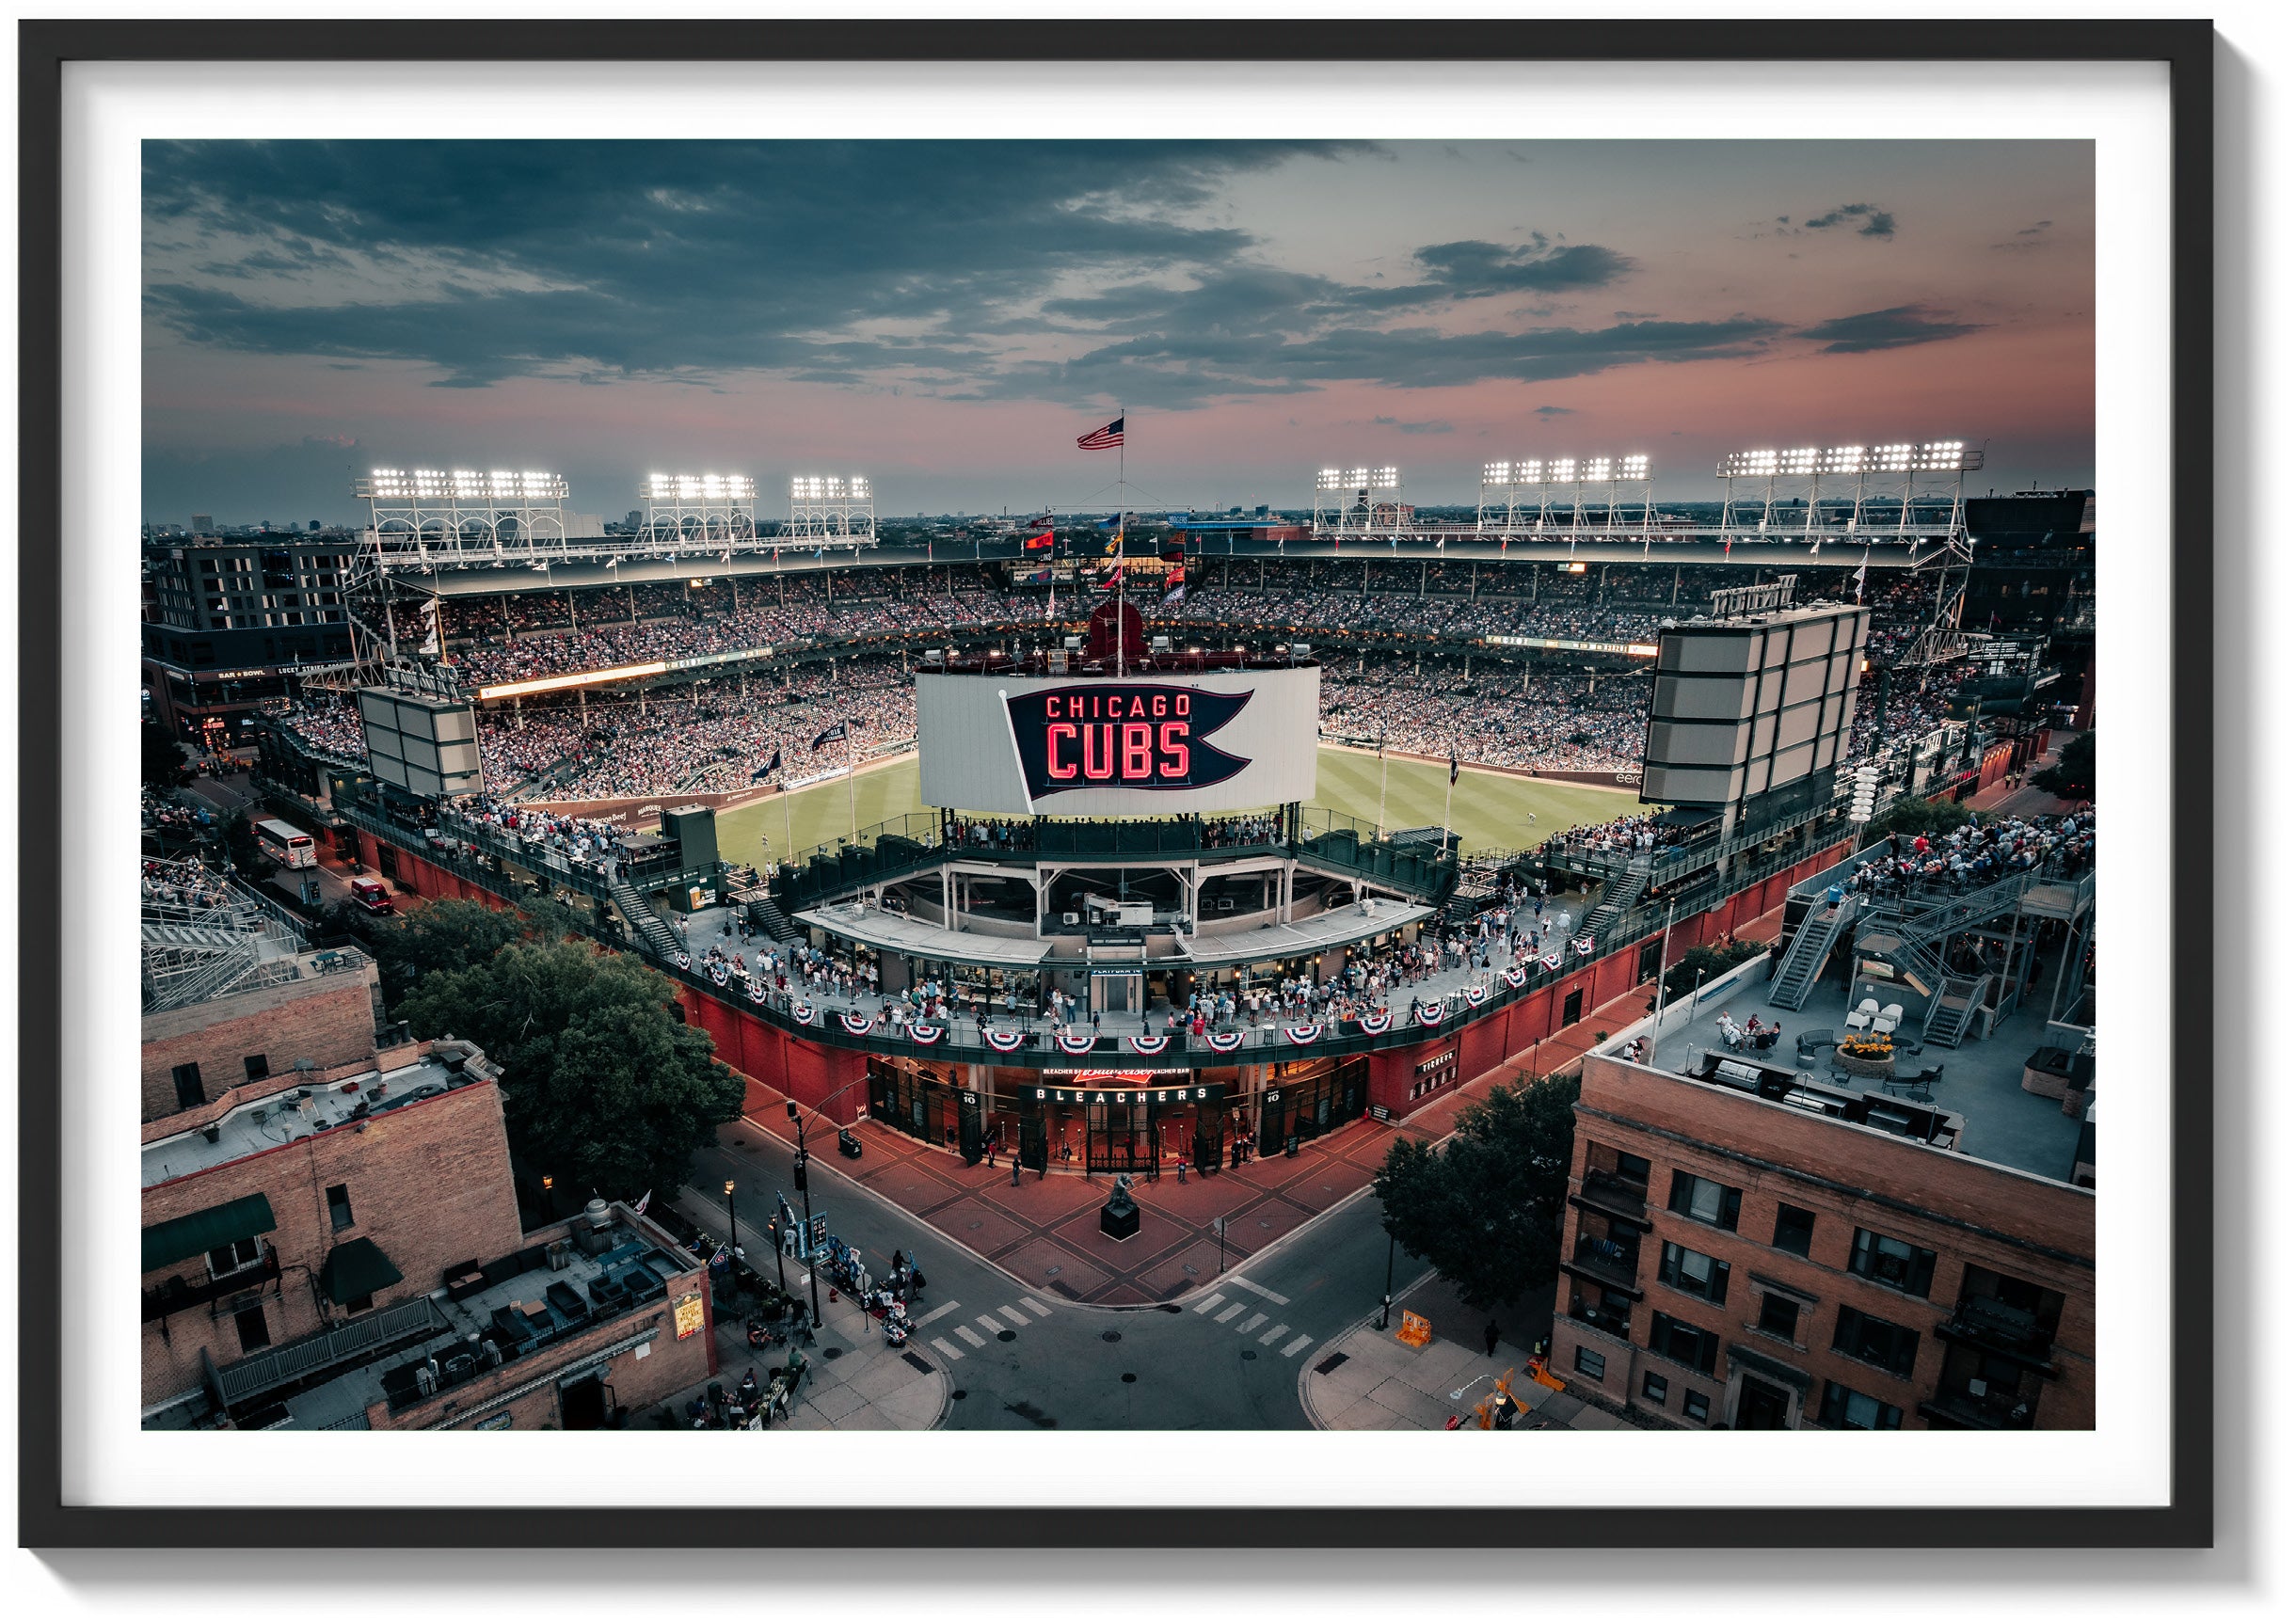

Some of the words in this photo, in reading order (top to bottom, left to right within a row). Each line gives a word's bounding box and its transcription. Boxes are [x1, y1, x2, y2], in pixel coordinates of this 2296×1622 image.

[1046, 694, 1190, 718] CHICAGO
[1047, 721, 1189, 779] CUBS
[1423, 1052, 1453, 1073] TICKETS
[964, 1096, 976, 1105] 10
[1037, 1089, 1206, 1103] BLEACHERS
[1268, 1094, 1280, 1103] 10
